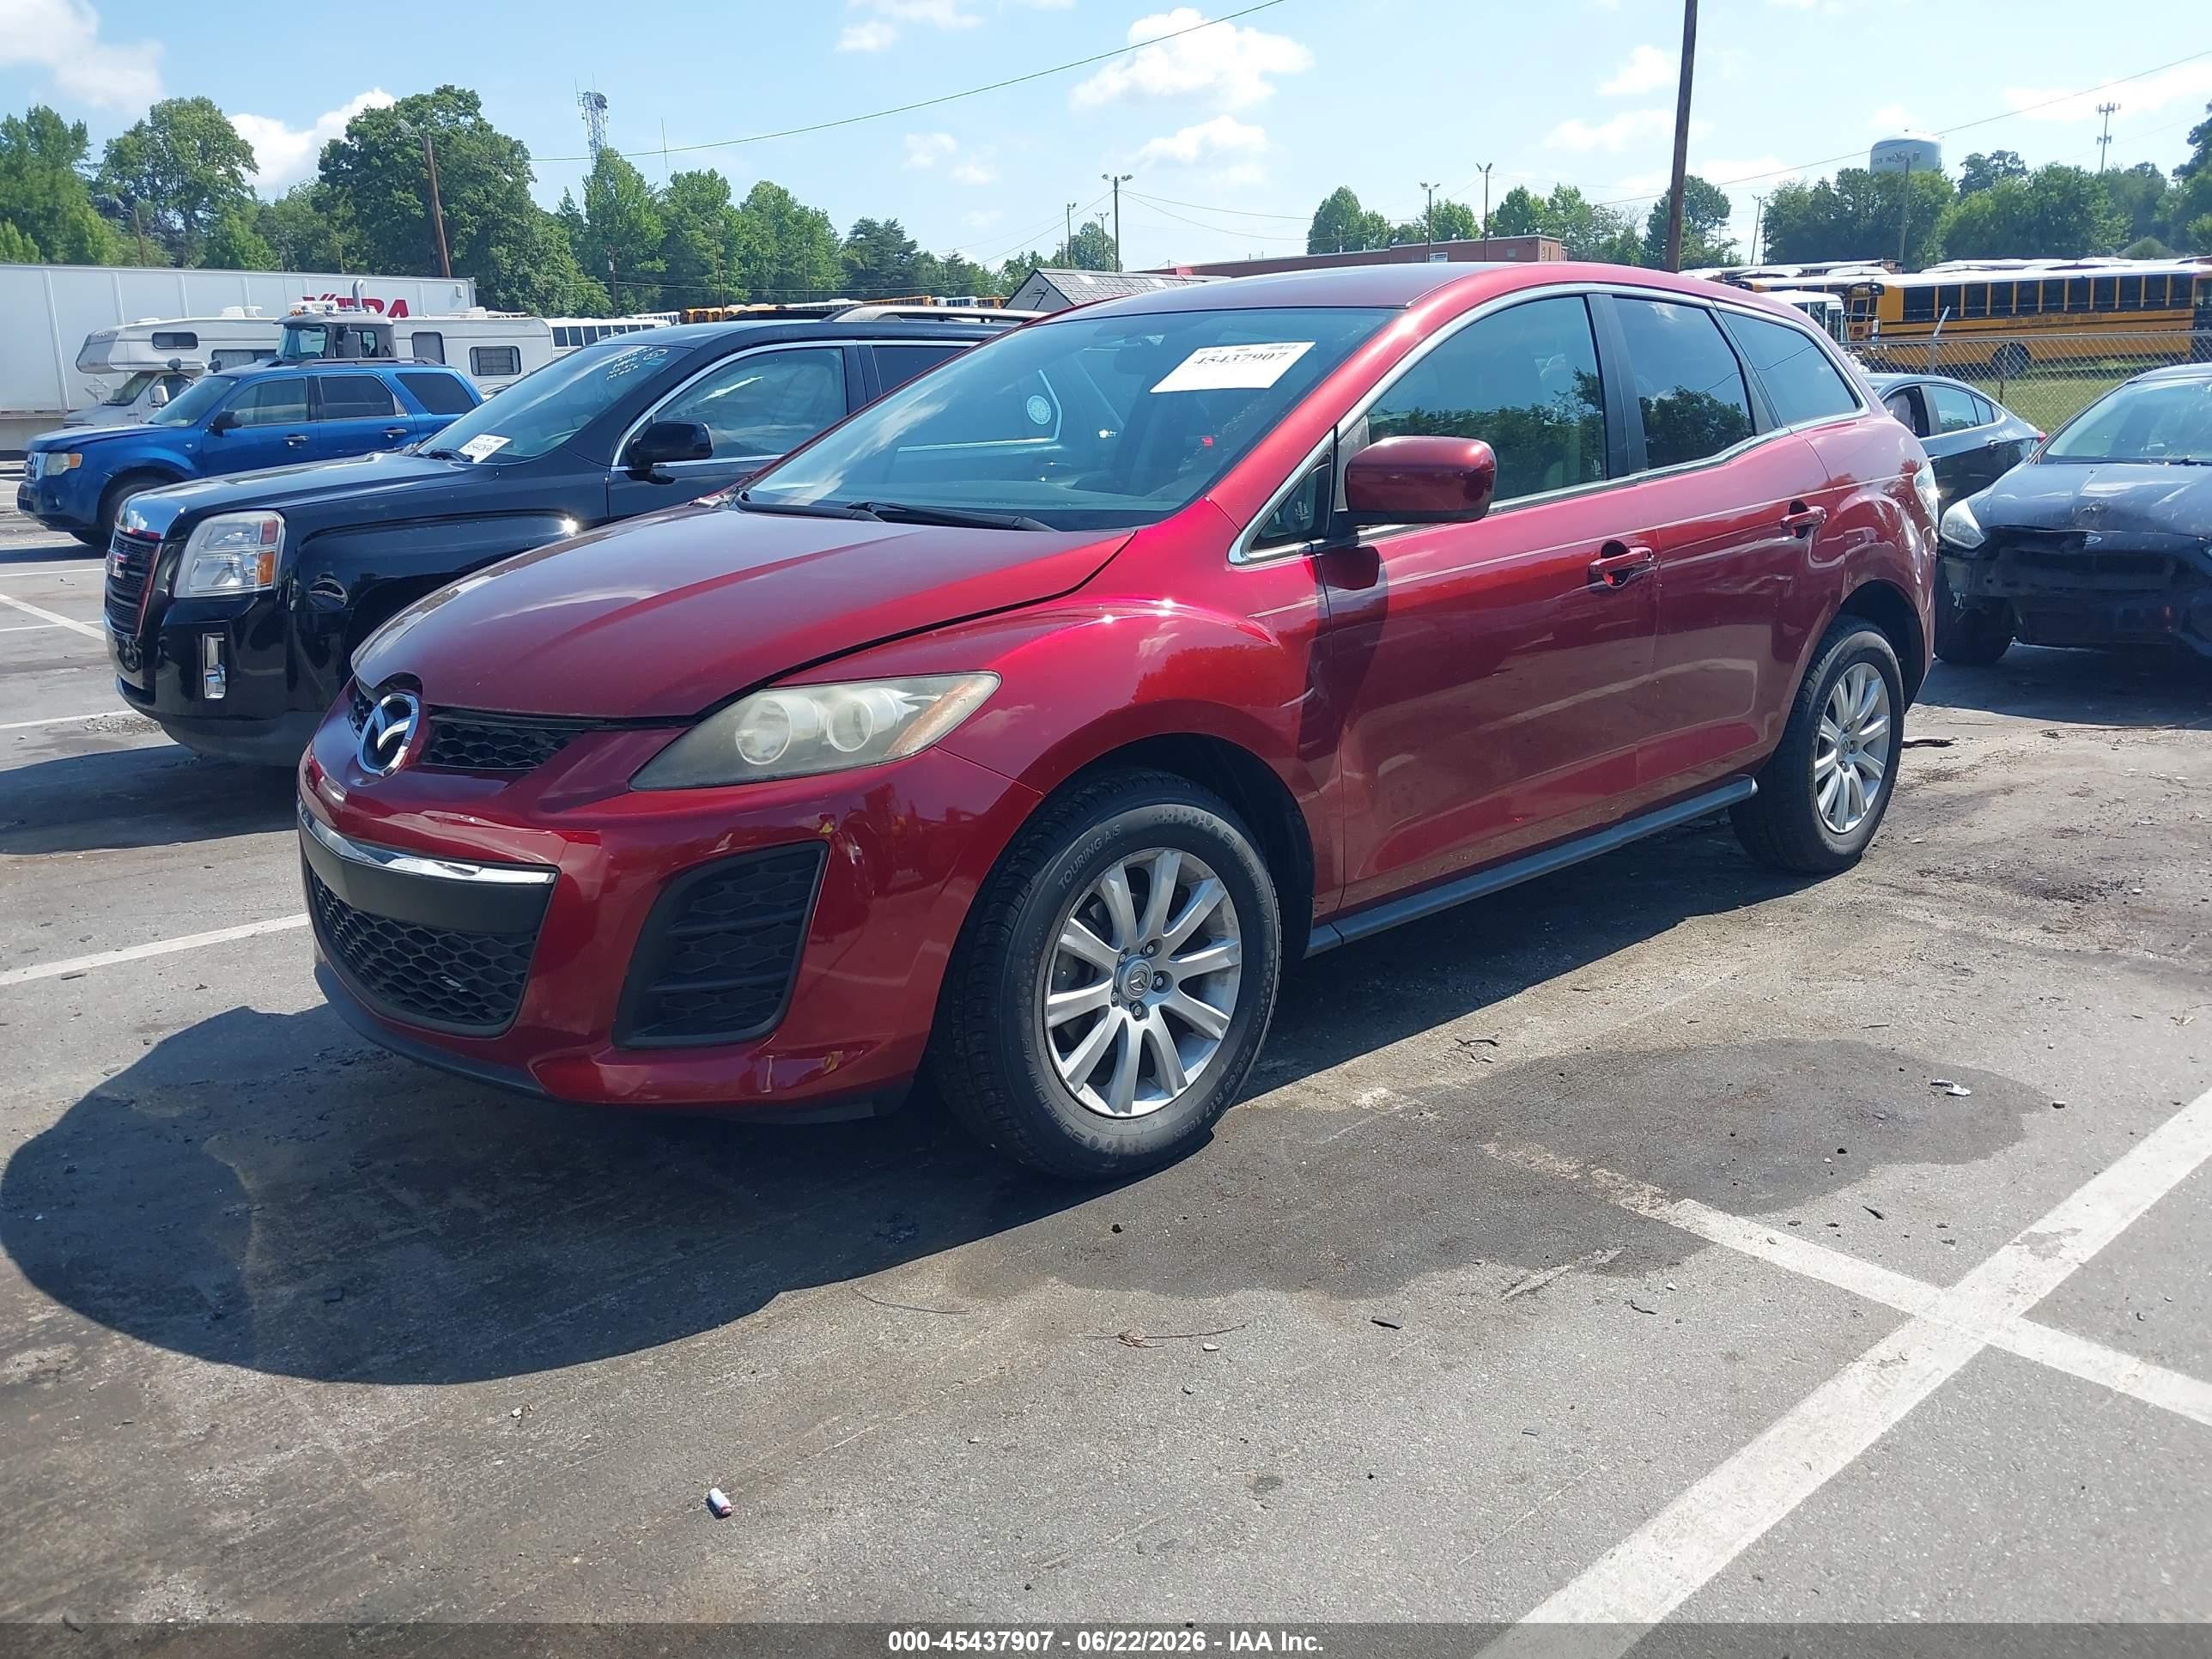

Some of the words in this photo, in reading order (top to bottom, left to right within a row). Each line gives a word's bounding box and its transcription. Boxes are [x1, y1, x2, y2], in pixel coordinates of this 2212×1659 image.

[1194, 351, 1289, 365] 45437907
[1058, 837, 1103, 890] TOURING
[1104, 823, 1121, 844] A/S
